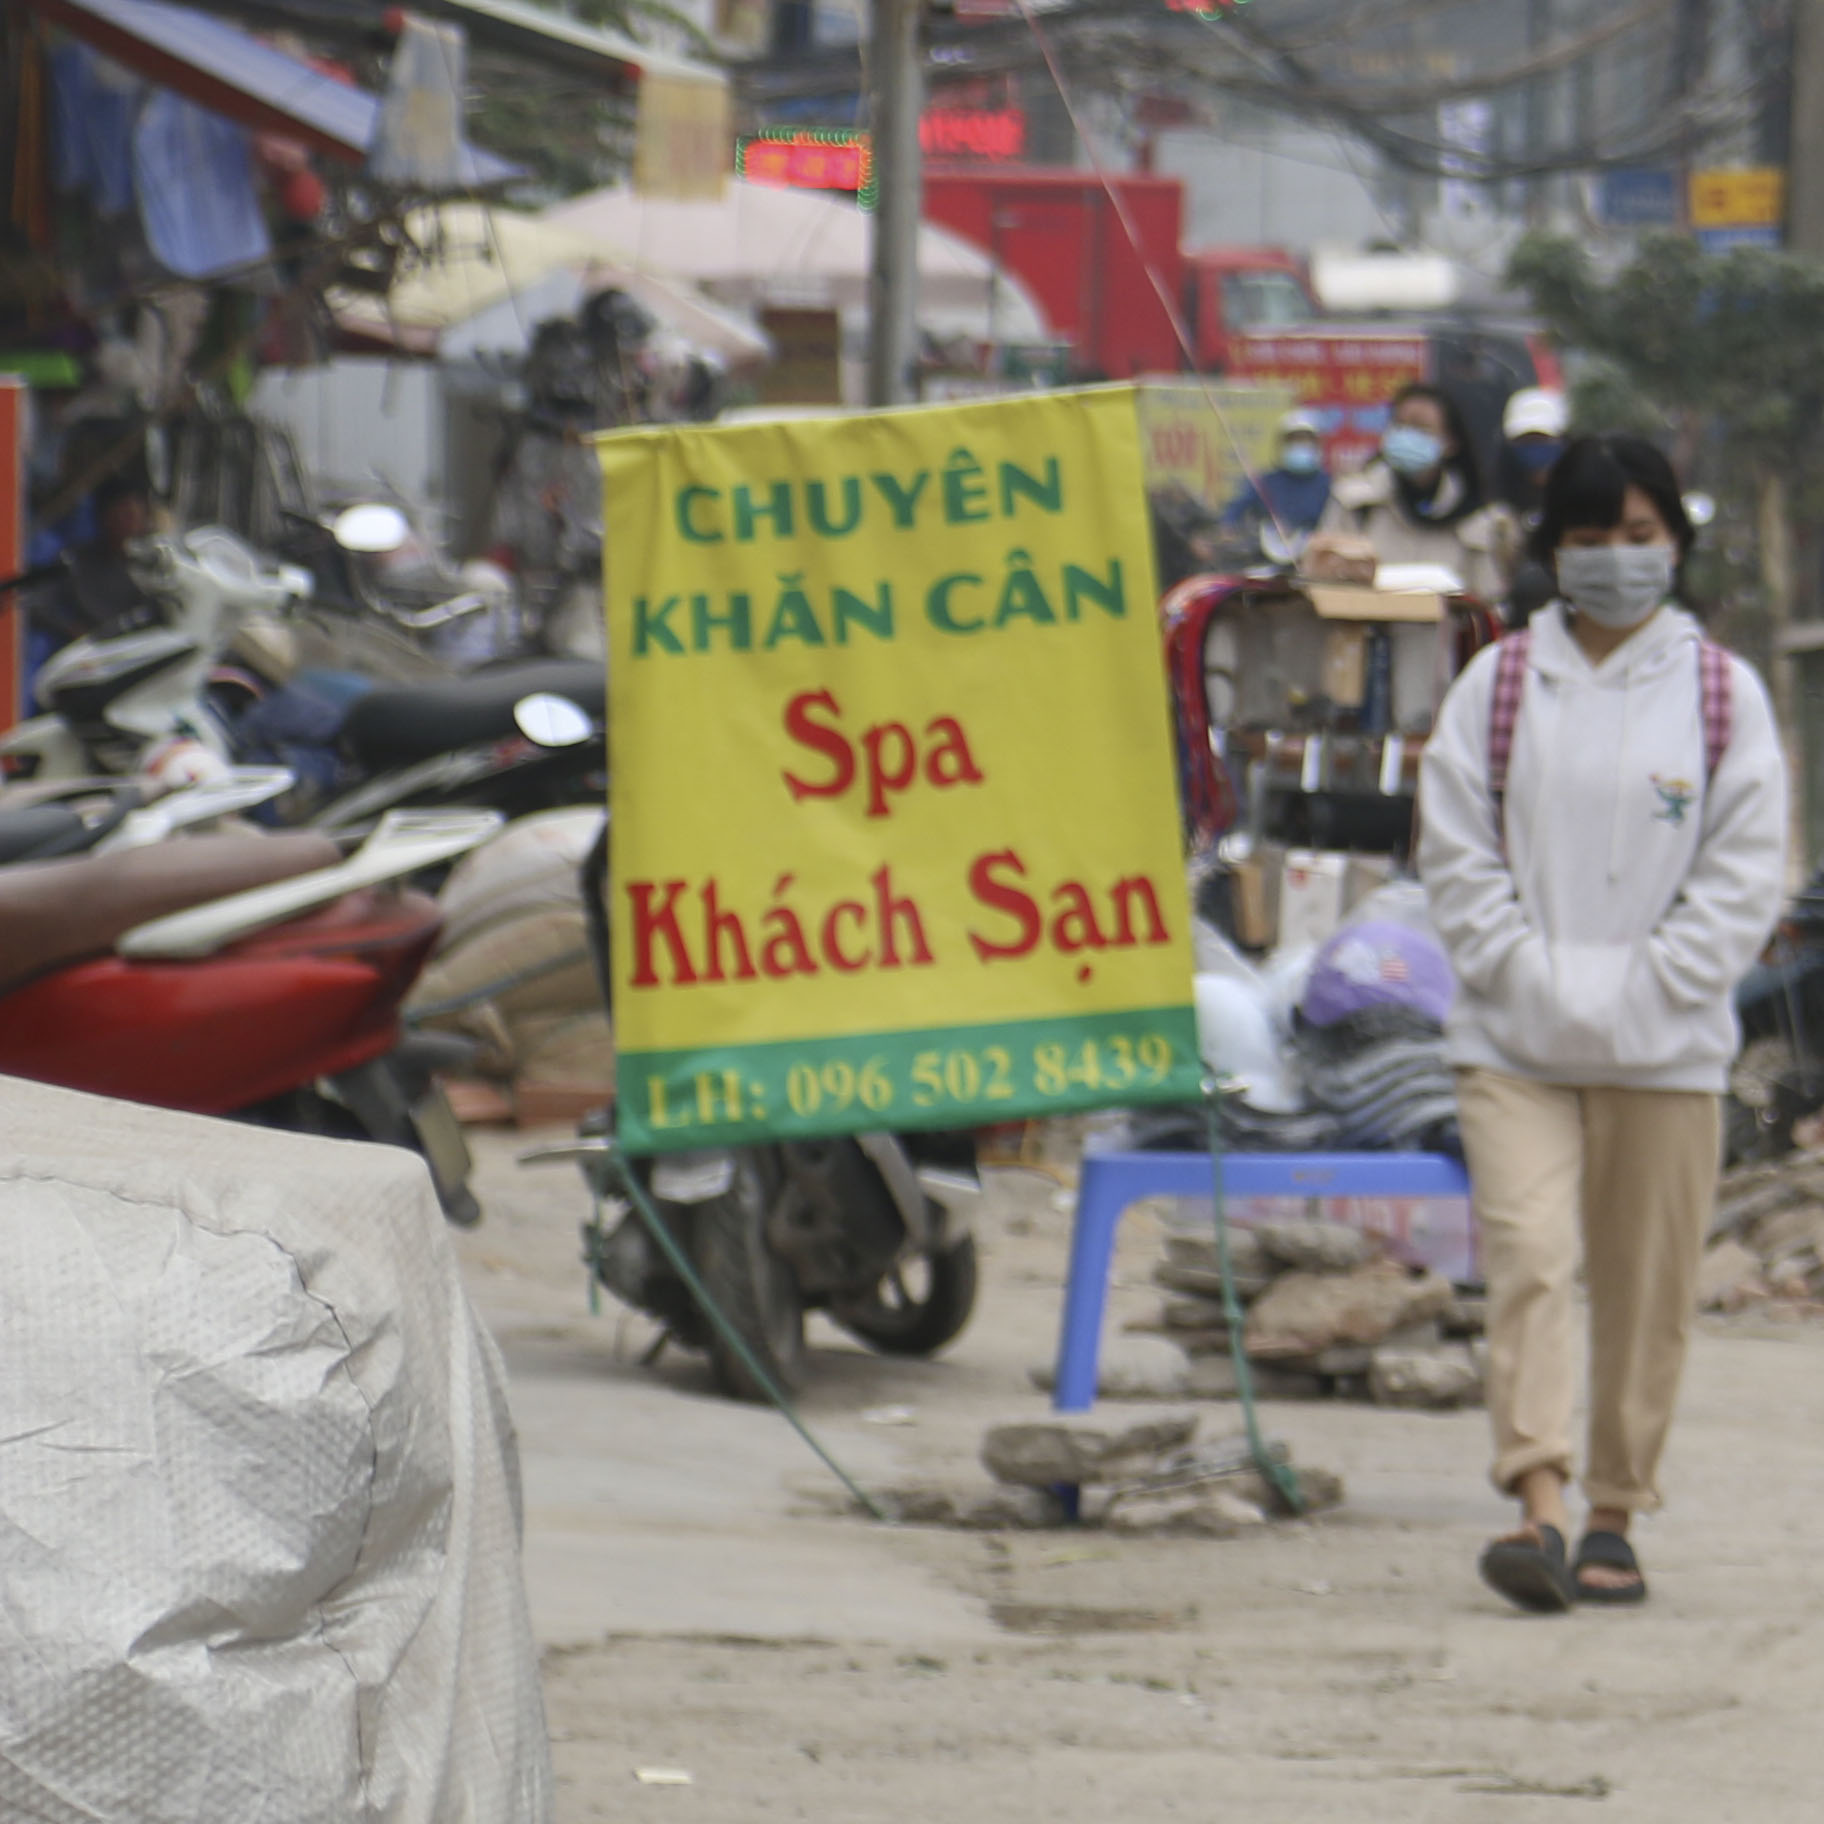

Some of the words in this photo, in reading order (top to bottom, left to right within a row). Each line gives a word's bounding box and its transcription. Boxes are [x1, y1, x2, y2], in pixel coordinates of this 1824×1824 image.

[675, 447, 1065, 545] CHUYÊN
[631, 574, 895, 657] KHĂN
[924, 548, 1128, 635] CÂN
[781, 688, 984, 817] Spa
[625, 864, 935, 988] Khách
[967, 848, 1172, 984] Sạn
[646, 1069, 766, 1130] LH:
[786, 1060, 892, 1117] 096
[910, 1048, 1015, 1108] 502
[1033, 1033, 1173, 1095] 8439
